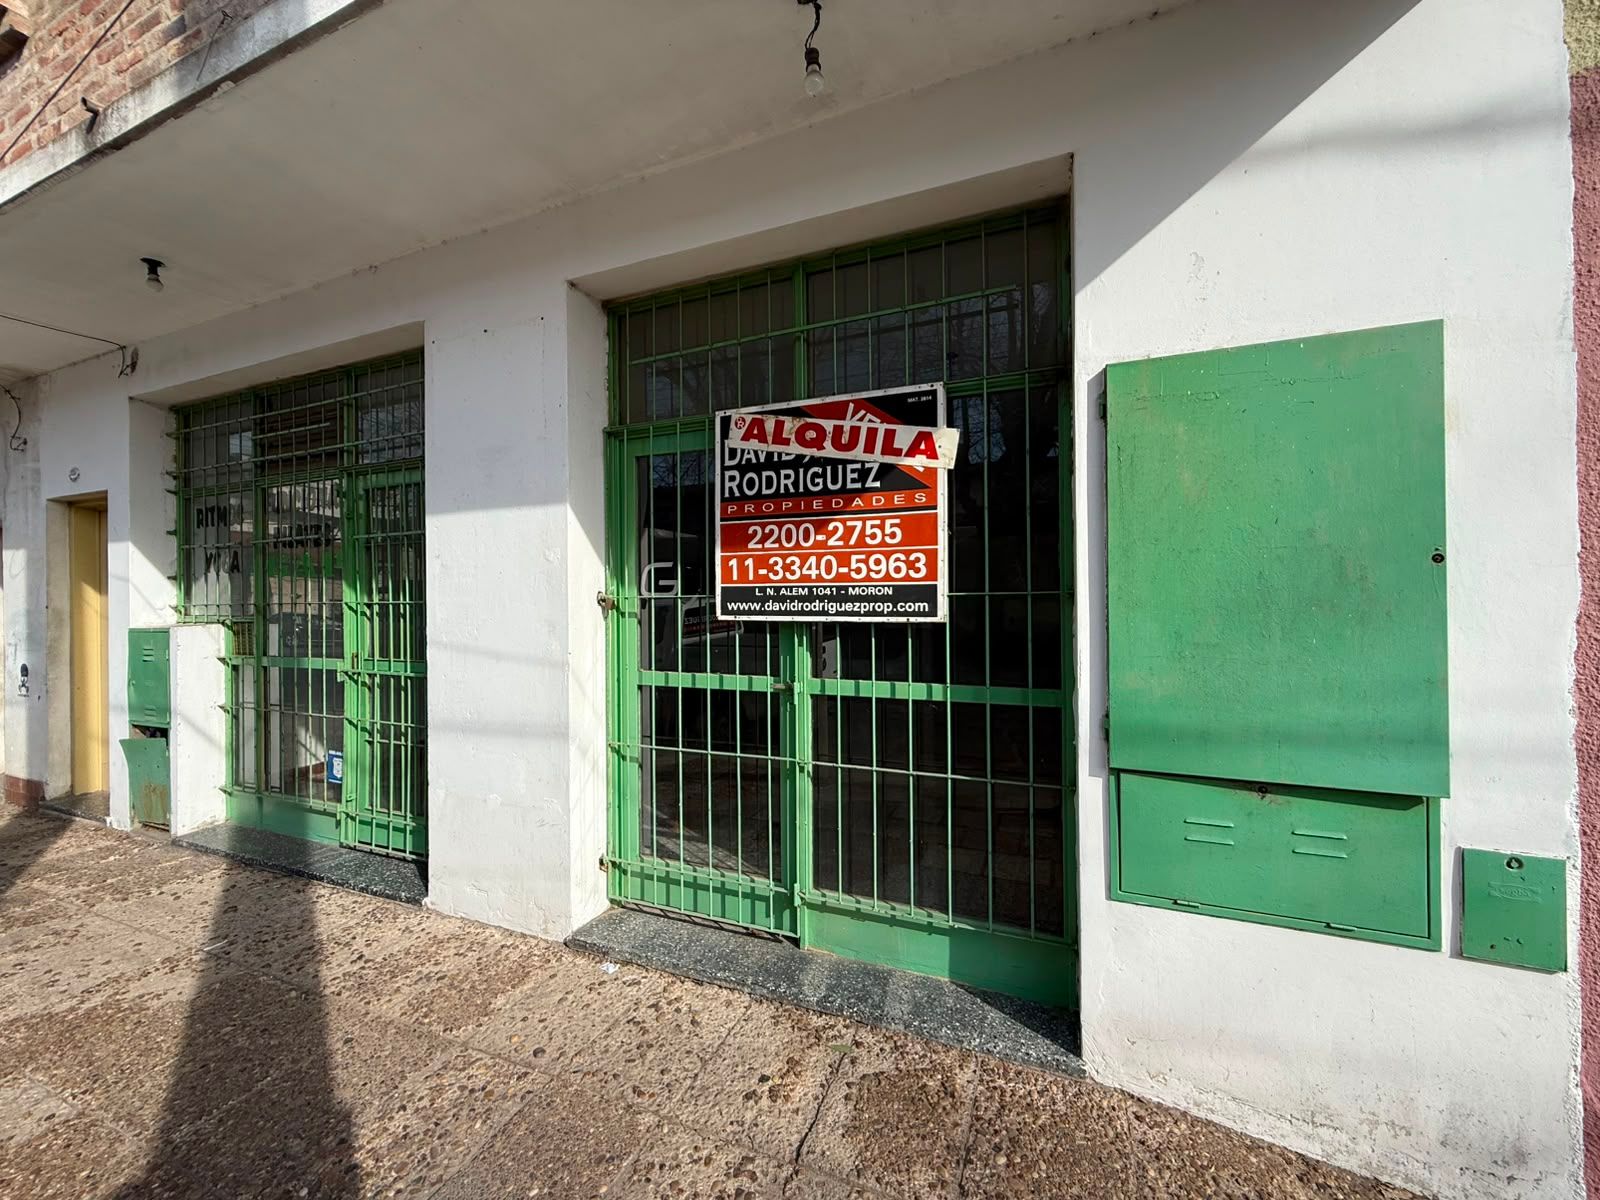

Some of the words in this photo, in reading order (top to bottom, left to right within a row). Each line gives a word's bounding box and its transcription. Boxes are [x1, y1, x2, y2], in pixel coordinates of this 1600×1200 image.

[740, 417, 939, 461] ALQUILA
[724, 462, 881, 498] RODRIGUEZ
[728, 493, 927, 515] PROPIEDADES
[747, 519, 903, 549] 2200-2755
[728, 552, 928, 581] 11-3340-5963
[766, 587, 777, 596] N.
[779, 587, 809, 596] ALEM
[812, 586, 837, 595] 1041
[848, 586, 893, 596] MORON
[727, 599, 929, 615] www.davidrodriguezprop.com
